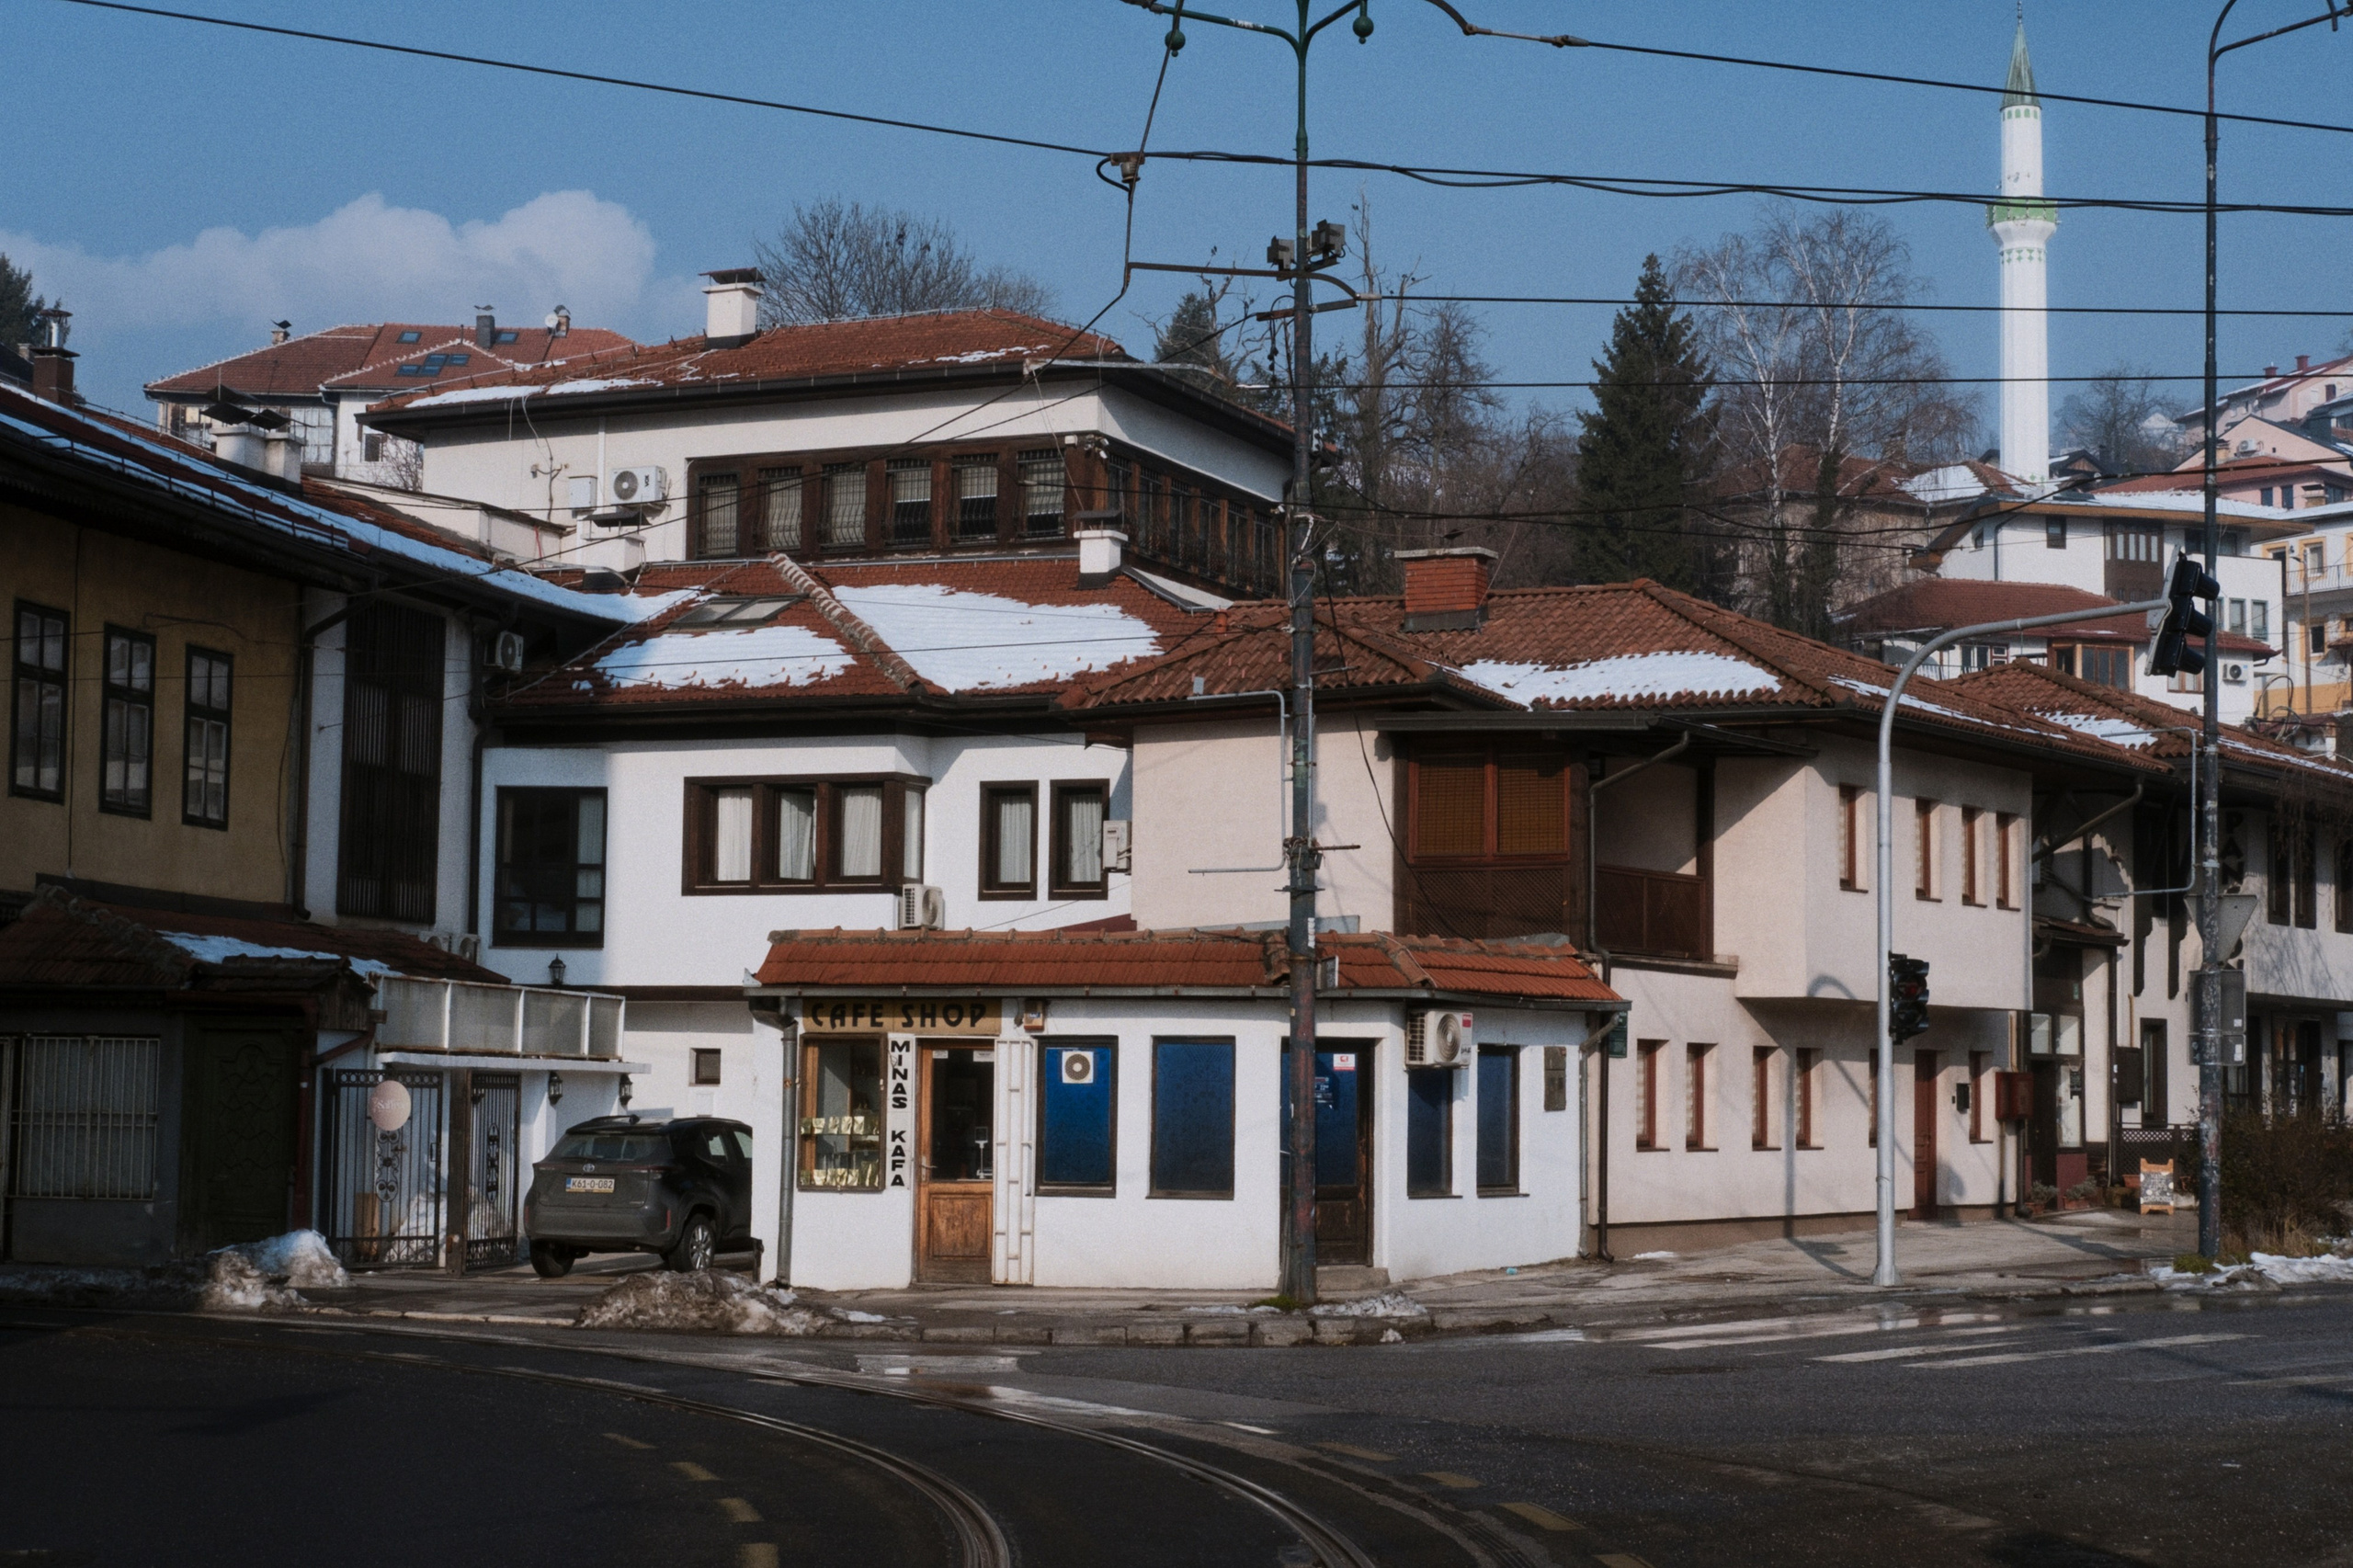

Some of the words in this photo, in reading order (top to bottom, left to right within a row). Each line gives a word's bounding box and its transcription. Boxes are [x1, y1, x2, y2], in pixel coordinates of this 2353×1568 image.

[813, 1003, 883, 1029] CAFE
[902, 1003, 986, 1028] SHOP
[891, 1040, 910, 1108] MINAS
[891, 1130, 906, 1187] KAFA
